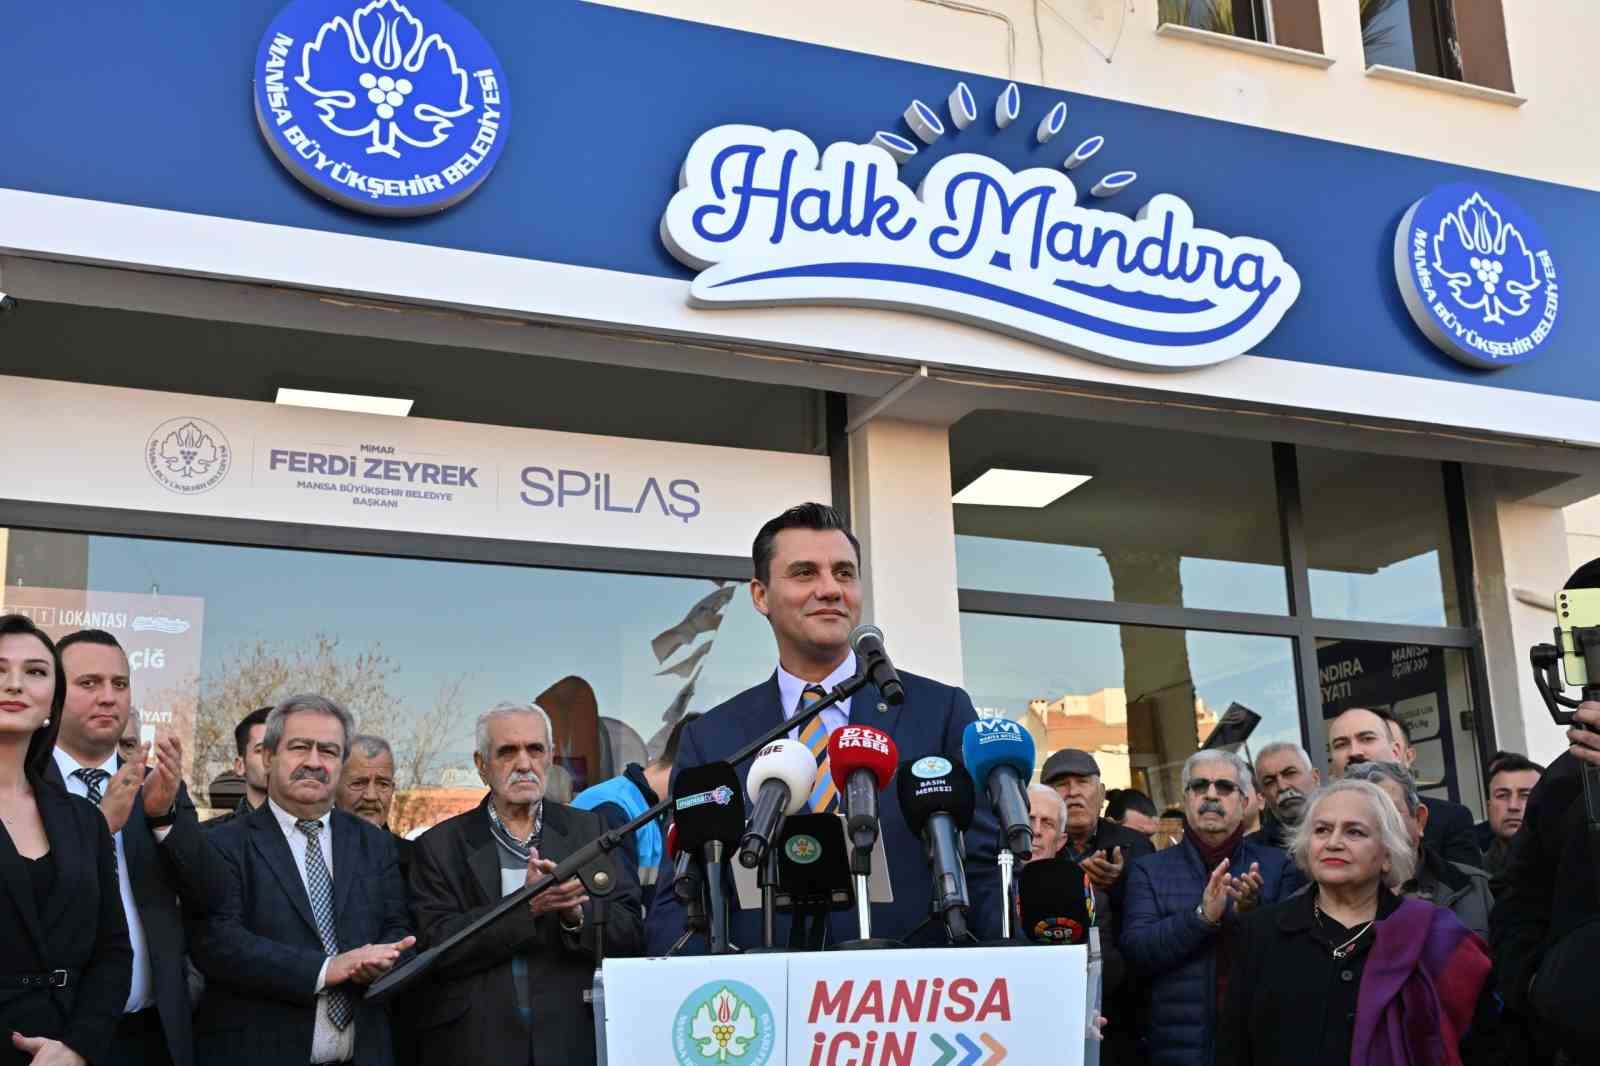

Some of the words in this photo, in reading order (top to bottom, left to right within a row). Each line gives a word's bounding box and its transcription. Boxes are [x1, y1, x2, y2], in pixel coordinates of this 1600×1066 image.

[283, 125, 445, 198] BÜYÜKŞEHİR
[441, 68, 501, 185] BELEDİYESİ
[692, 143, 918, 245] Halk
[363, 457, 479, 488] ZEYREK
[59, 608, 127, 628] LOKANTASI
[1320, 657, 1364, 683] NDIRA
[1320, 680, 1352, 702] YATI
[839, 739, 889, 755] HABER
